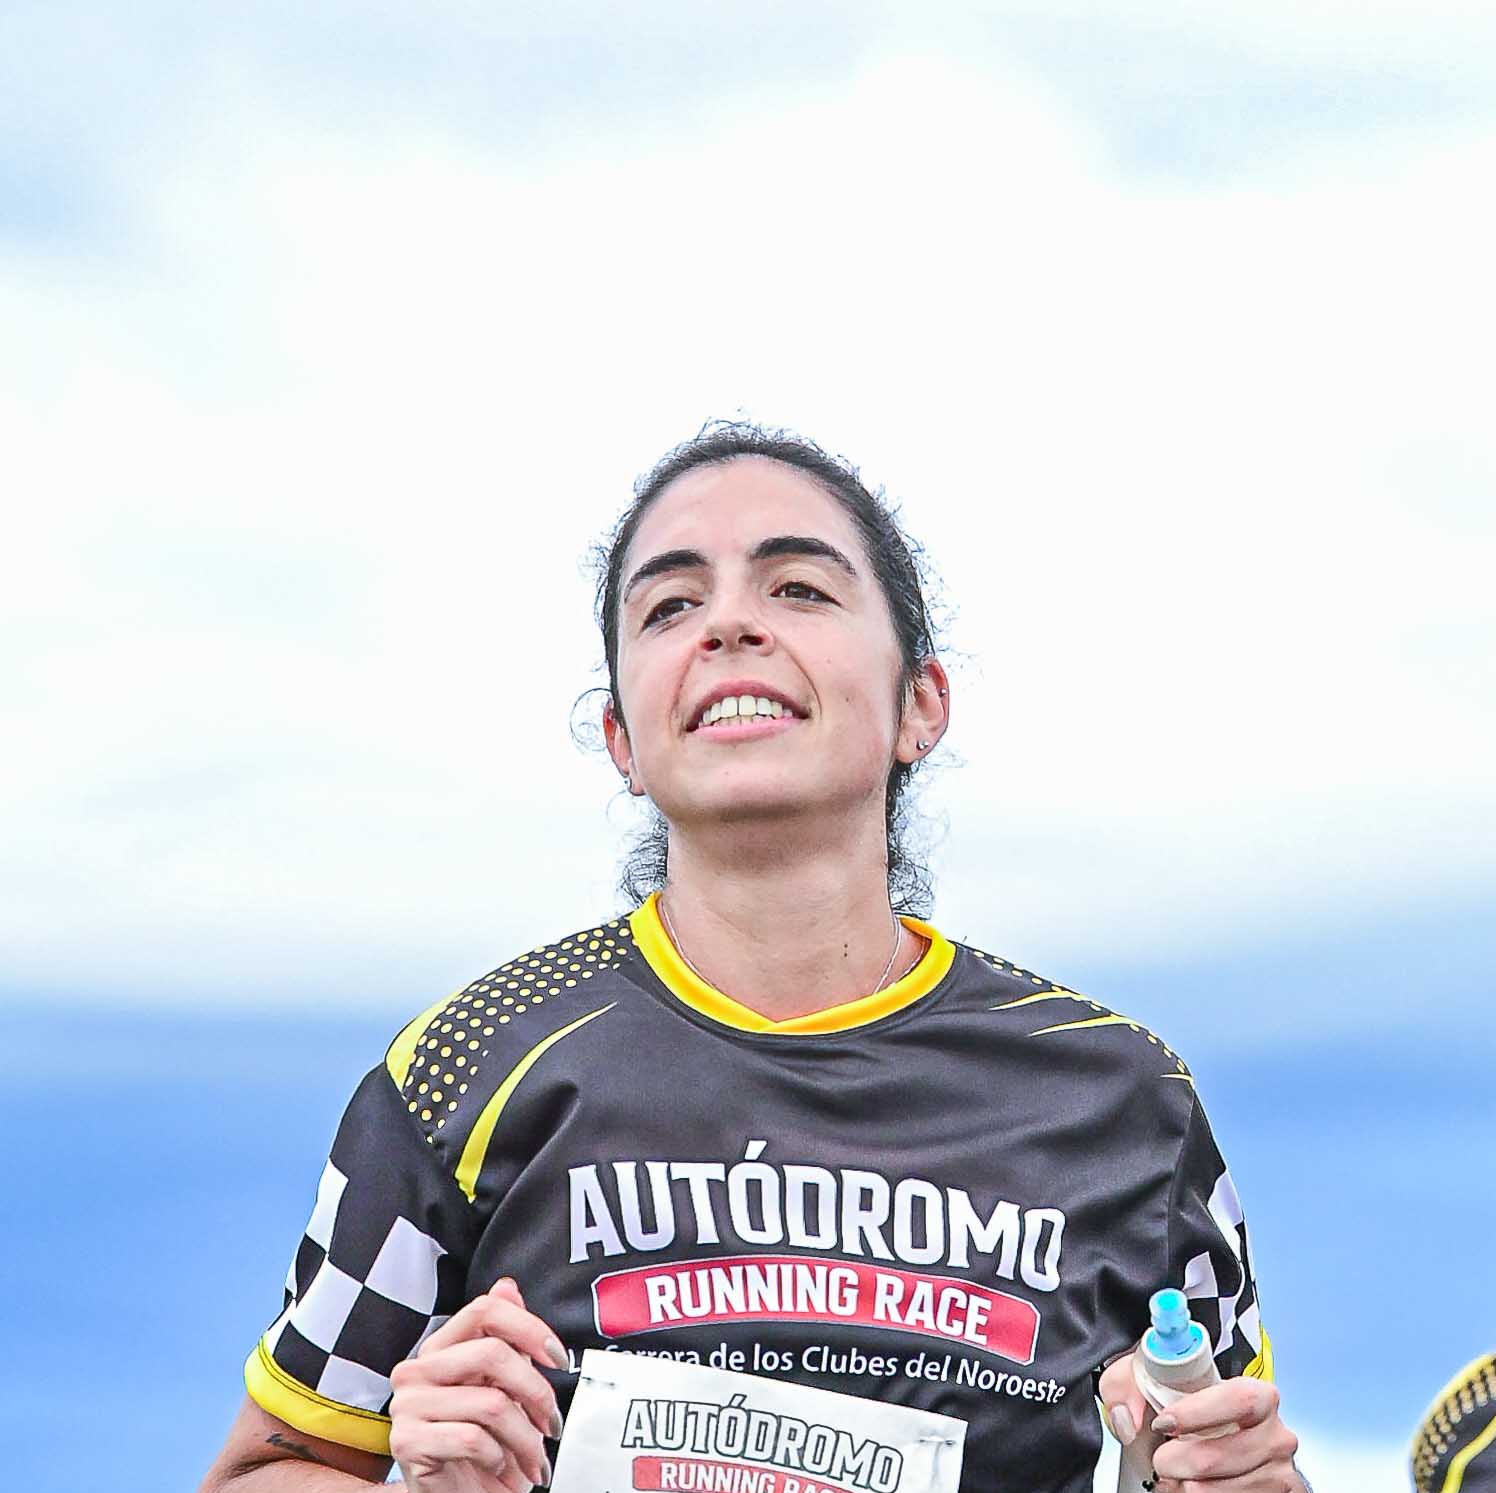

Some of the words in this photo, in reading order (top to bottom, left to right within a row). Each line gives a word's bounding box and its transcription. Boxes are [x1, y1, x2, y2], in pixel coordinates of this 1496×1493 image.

[568, 1140, 1067, 1292] AUTÓDROMO
[645, 1264, 860, 1324] RUNNING
[873, 1272, 993, 1345] RACE
[709, 1342, 746, 1371] de
[753, 1343, 794, 1372] los
[801, 1346, 899, 1378] Clubes
[905, 1352, 951, 1383] del
[956, 1358, 1067, 1404] Noroeste
